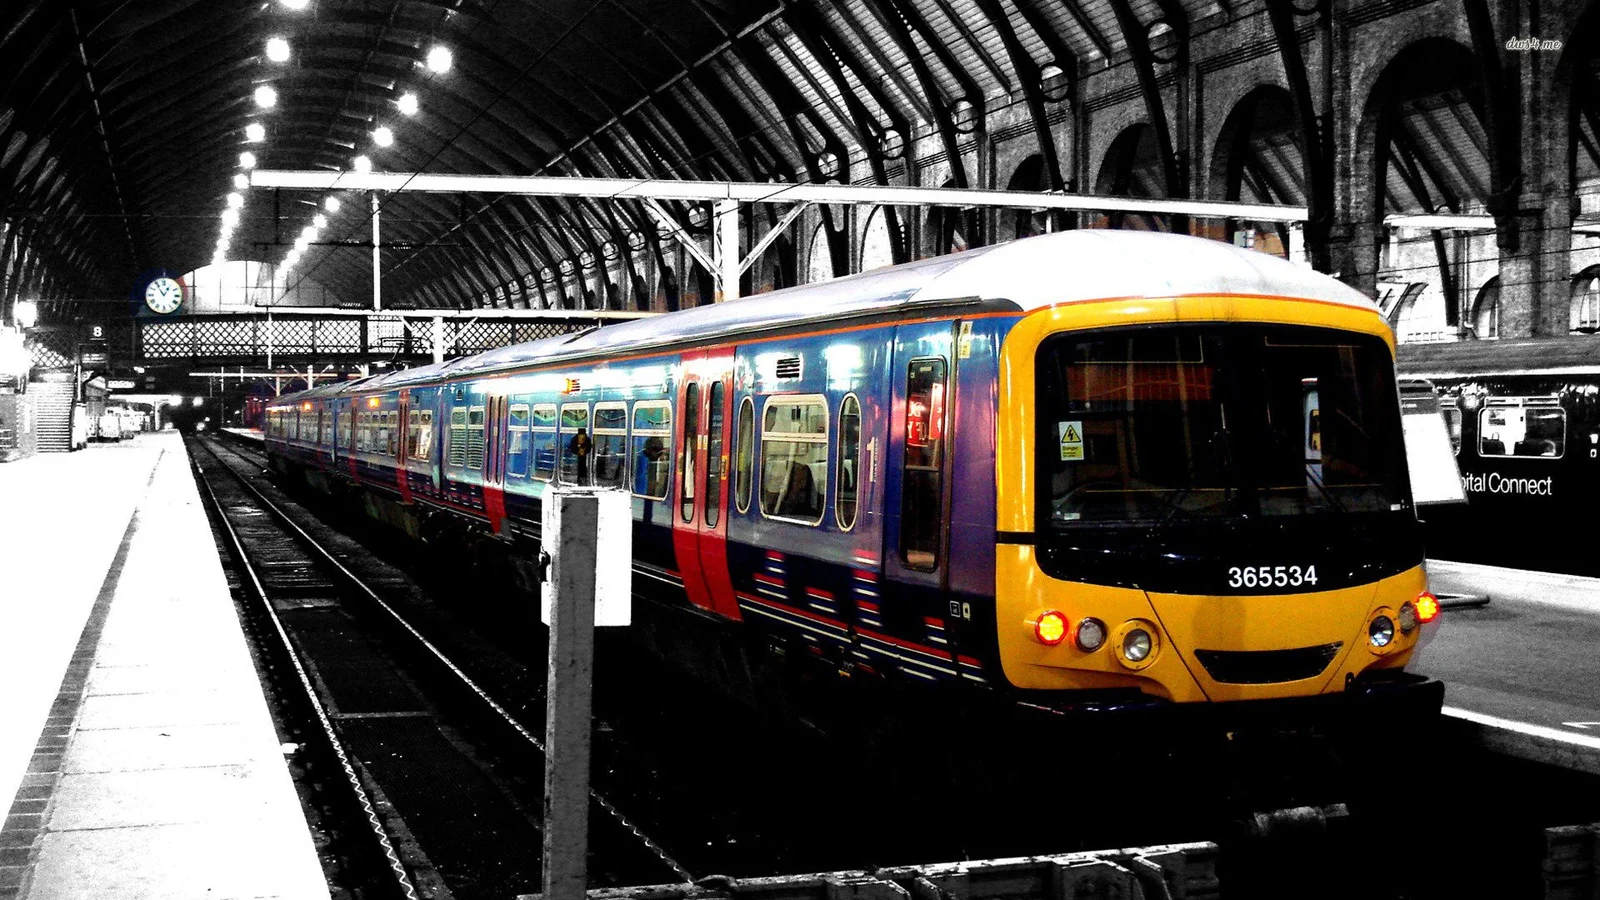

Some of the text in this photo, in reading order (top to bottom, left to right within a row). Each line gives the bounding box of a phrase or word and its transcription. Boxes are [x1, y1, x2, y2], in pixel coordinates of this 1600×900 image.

[93, 326, 102, 337] 8
[866, 436, 875, 482] 1
[1488, 472, 1552, 495] Connect
[1228, 565, 1318, 588] 365534
